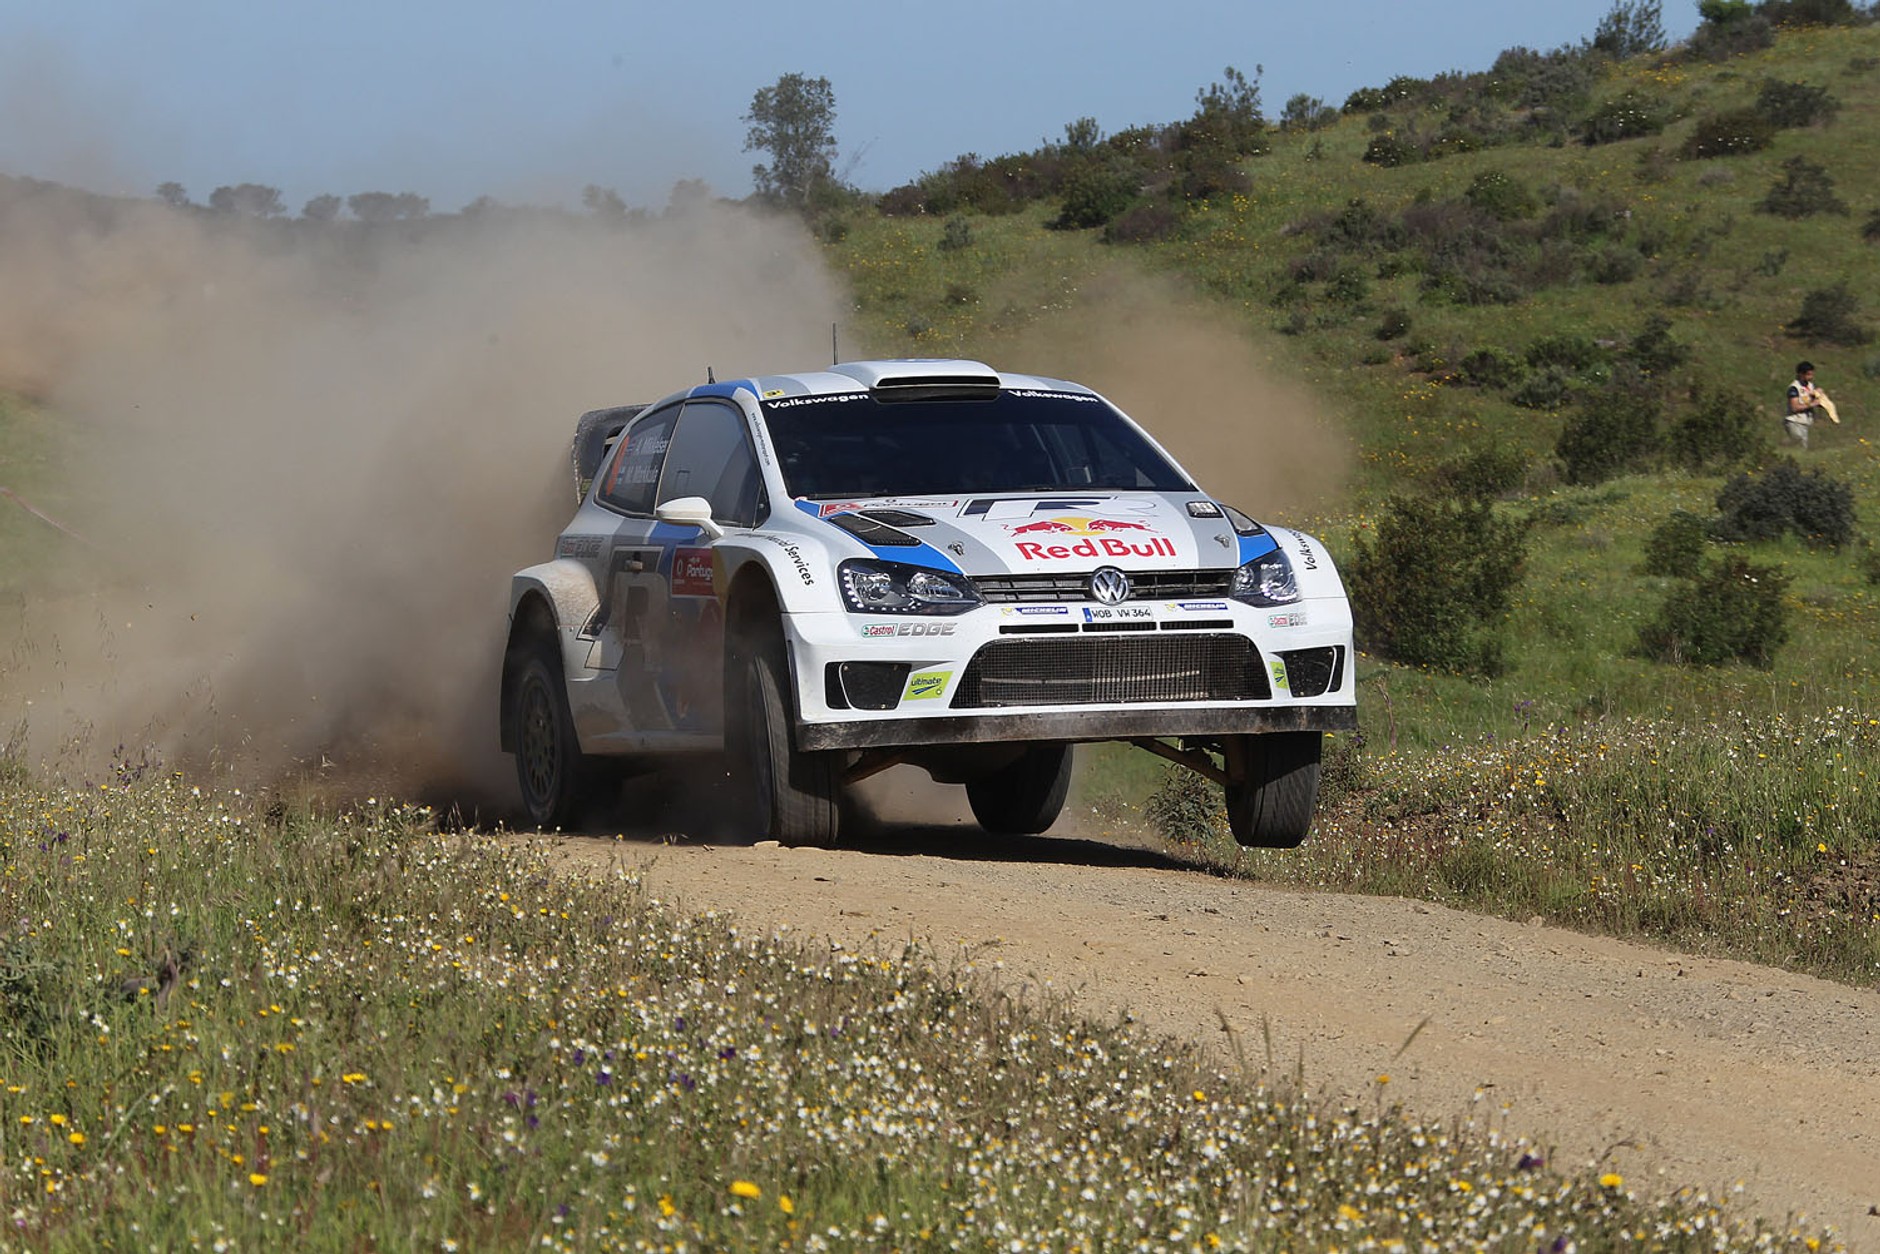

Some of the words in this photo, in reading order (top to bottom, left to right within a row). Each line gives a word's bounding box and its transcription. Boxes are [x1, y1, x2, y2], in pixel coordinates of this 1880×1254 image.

[767, 394, 869, 409] Volkswagen
[1015, 538, 1099, 560] Red
[1098, 537, 1177, 557] Bull
[784, 546, 815, 586] Services
[1091, 608, 1113, 619] WOB
[1131, 608, 1151, 618] 364
[868, 625, 895, 637] Castrol
[896, 622, 958, 637] EDGE
[911, 676, 943, 687] ultimate
